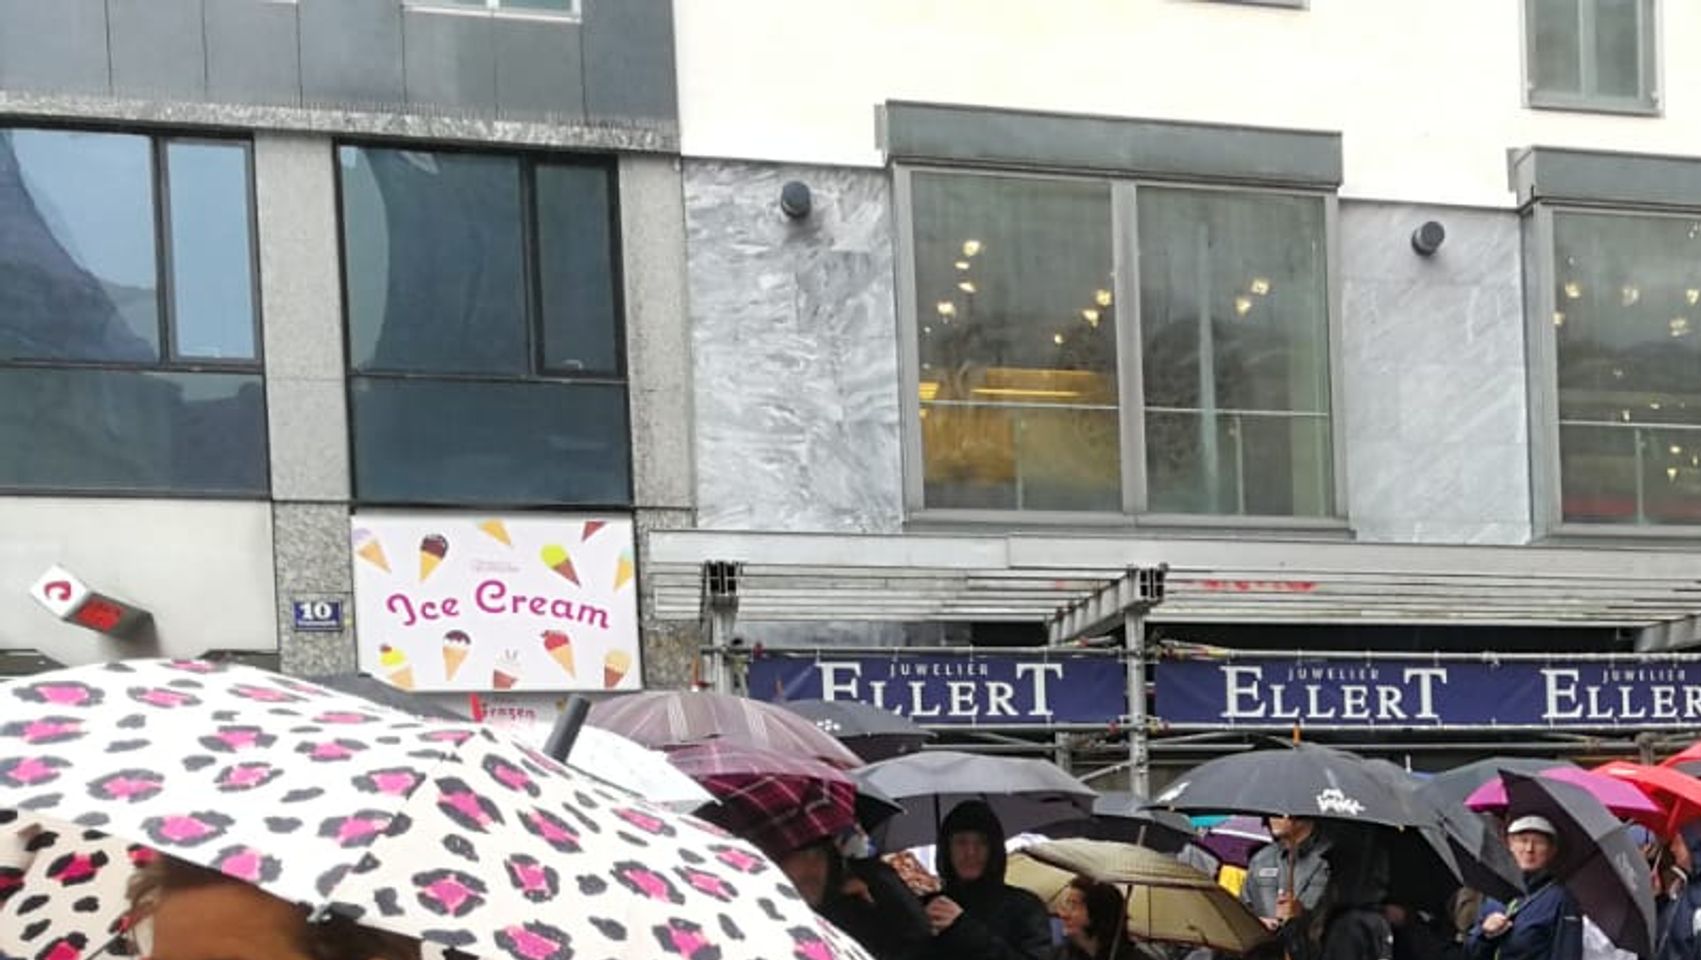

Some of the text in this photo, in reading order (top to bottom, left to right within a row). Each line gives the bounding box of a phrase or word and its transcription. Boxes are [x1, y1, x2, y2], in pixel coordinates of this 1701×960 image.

[299, 601, 332, 619] 10
[386, 579, 610, 629] Ice Cream
[890, 663, 988, 678] JUWELIER
[1288, 668, 1379, 682] JUWELIER
[1602, 669, 1686, 684] JUWELIER
[815, 660, 1063, 717] ELLERT
[1219, 665, 1448, 719] ELLERT
